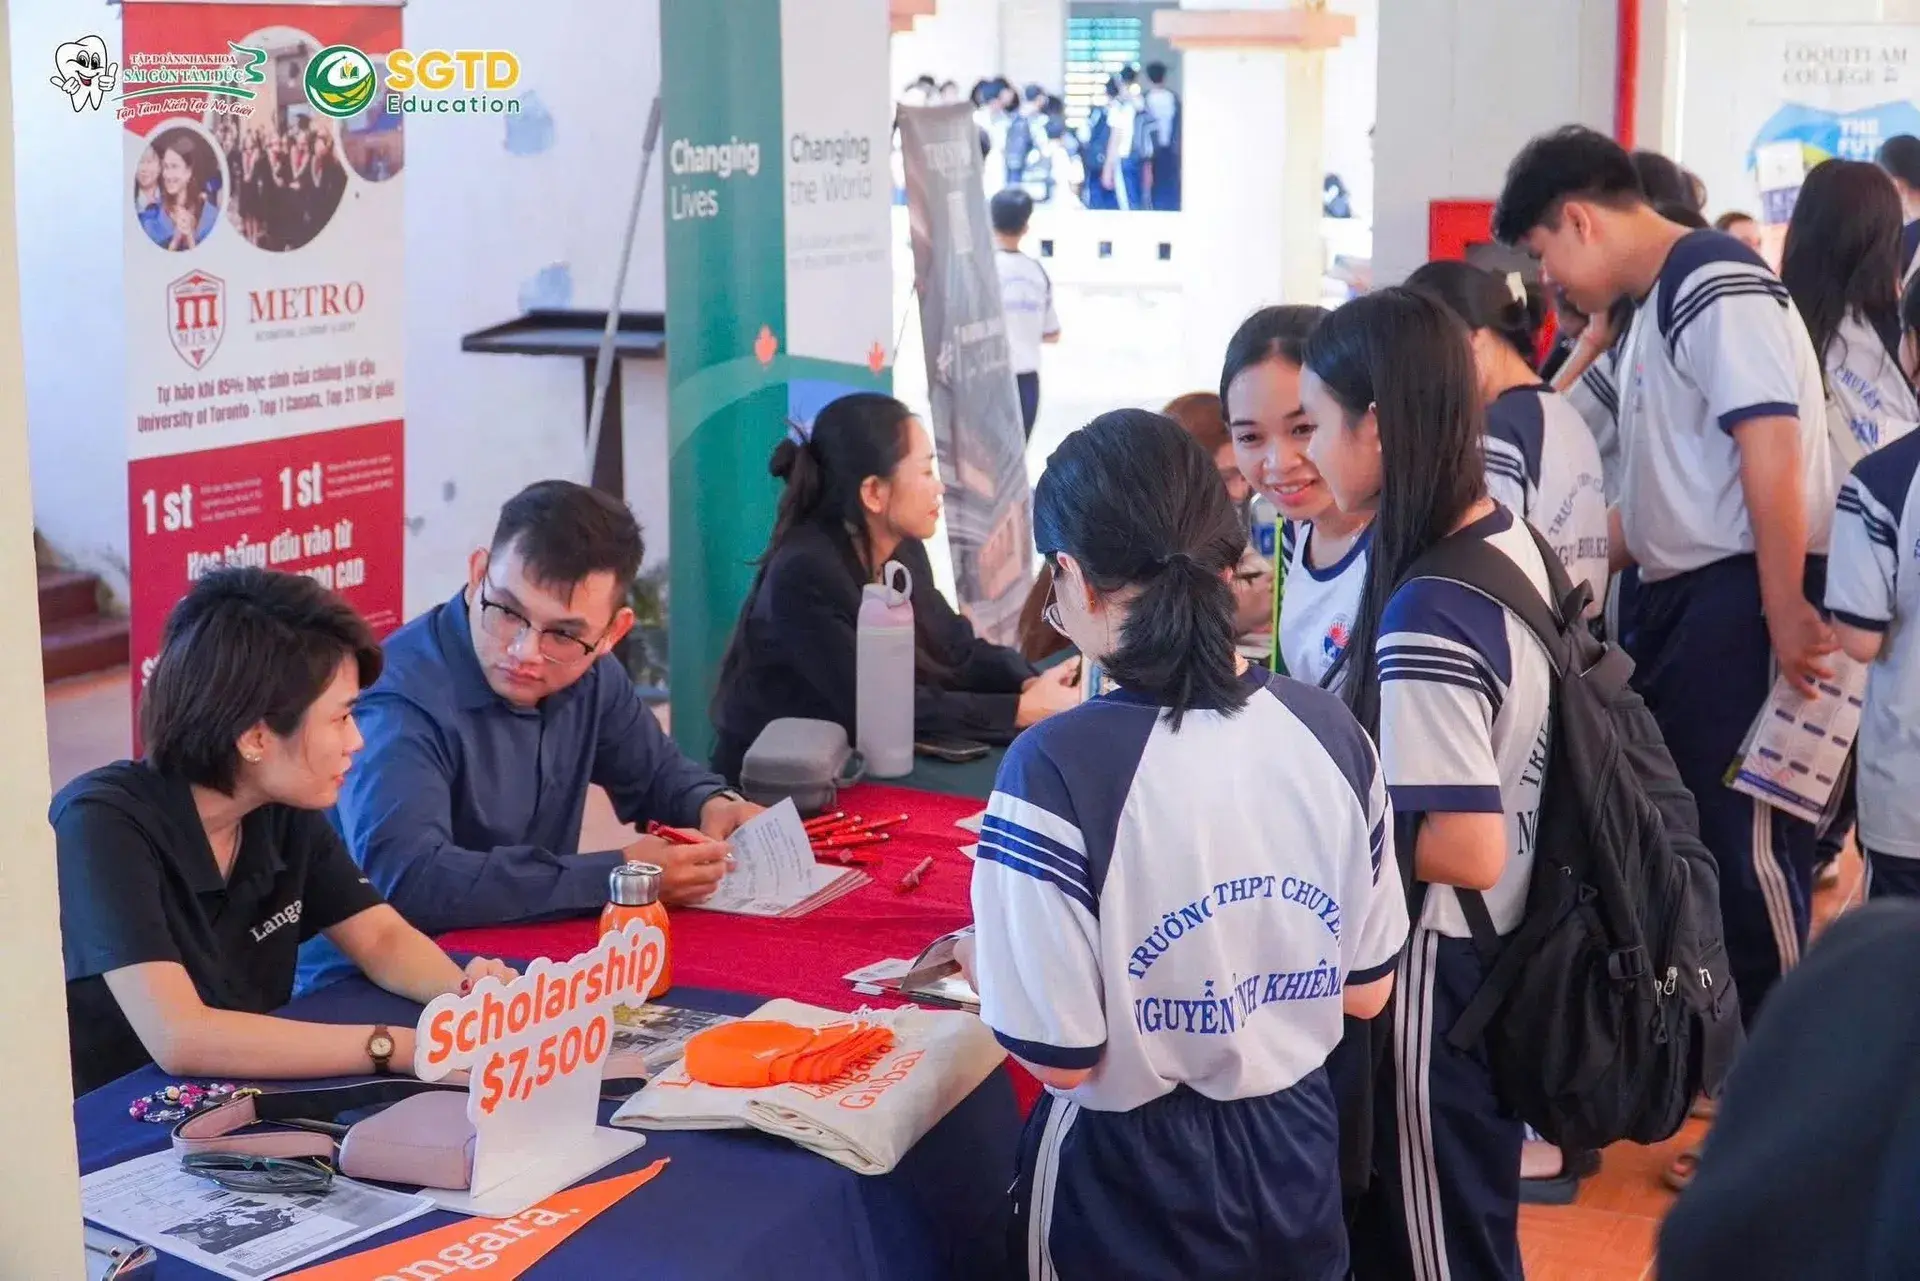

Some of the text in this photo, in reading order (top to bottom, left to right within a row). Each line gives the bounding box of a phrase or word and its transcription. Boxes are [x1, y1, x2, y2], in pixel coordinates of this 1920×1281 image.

[670, 136, 760, 177] Changing
[790, 131, 870, 166] Changing
[671, 185, 718, 220] Lives
[790, 171, 872, 206] the World
[249, 281, 365, 324] METRO
[137, 411, 193, 433] University
[197, 408, 207, 425] of
[210, 404, 249, 423] Toronto
[1213, 875, 1275, 906] THPT
[1281, 876, 1342, 948] CHUYÊ
[427, 933, 659, 1065] Scholarship
[1261, 958, 1341, 1004] KHIÊM
[480, 1015, 606, 1114] $7,500
[839, 1049, 926, 1109] Global
